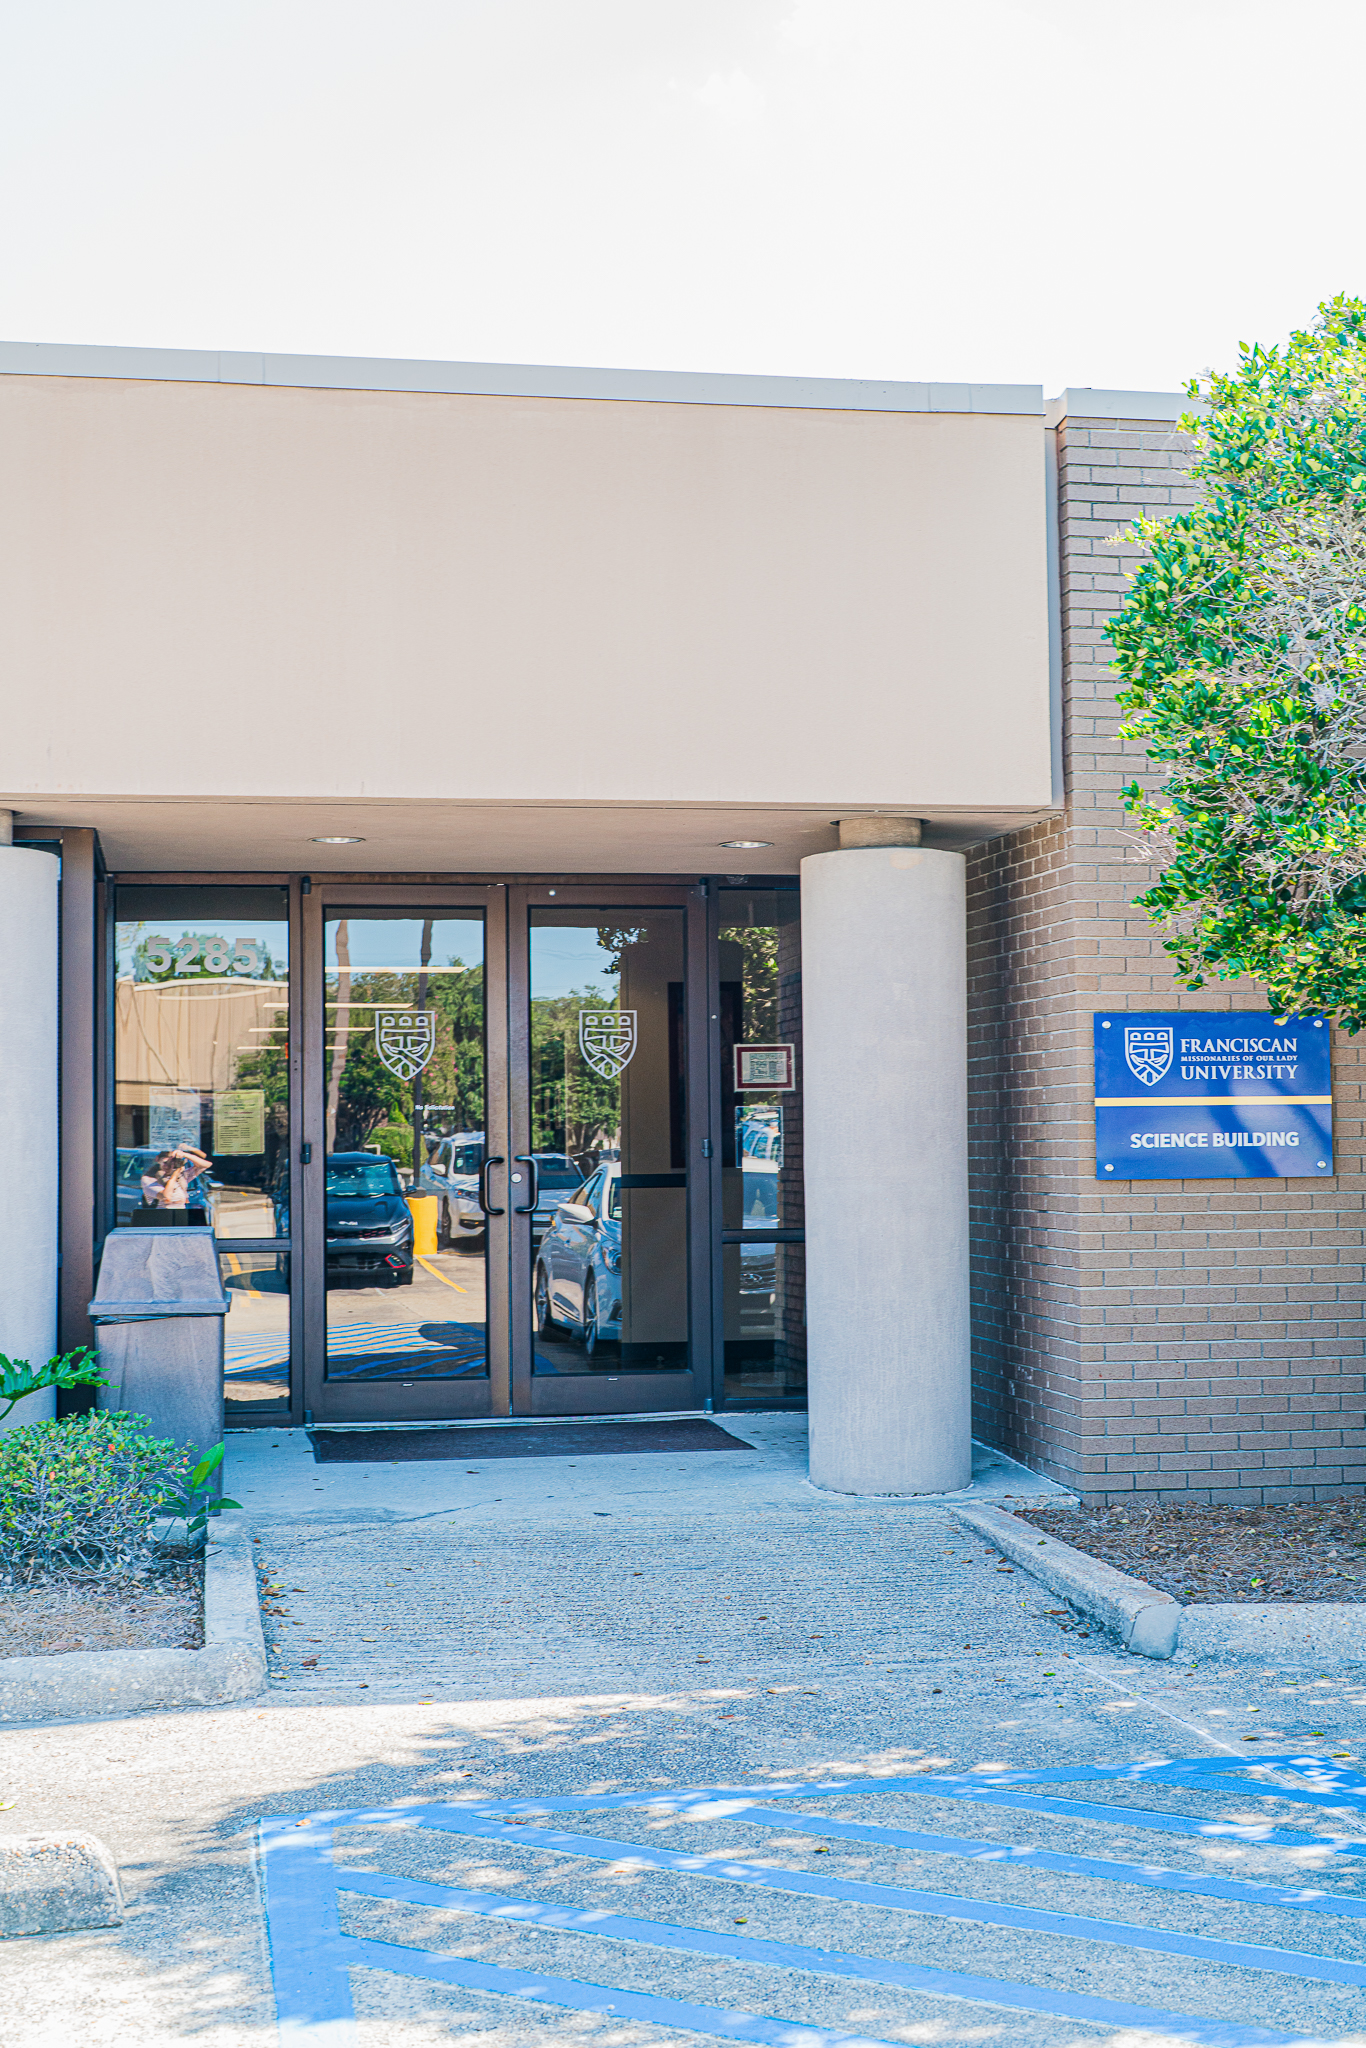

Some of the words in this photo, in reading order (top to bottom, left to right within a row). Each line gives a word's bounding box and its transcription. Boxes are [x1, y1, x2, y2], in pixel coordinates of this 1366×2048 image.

[146, 937, 258, 973] 5285
[1180, 1038, 1298, 1053] FRANCISCAN
[1180, 1065, 1299, 1080] UNIVERSITY
[1130, 1133, 1209, 1148] SCIENCE
[1212, 1131, 1300, 1147] BUILDING
